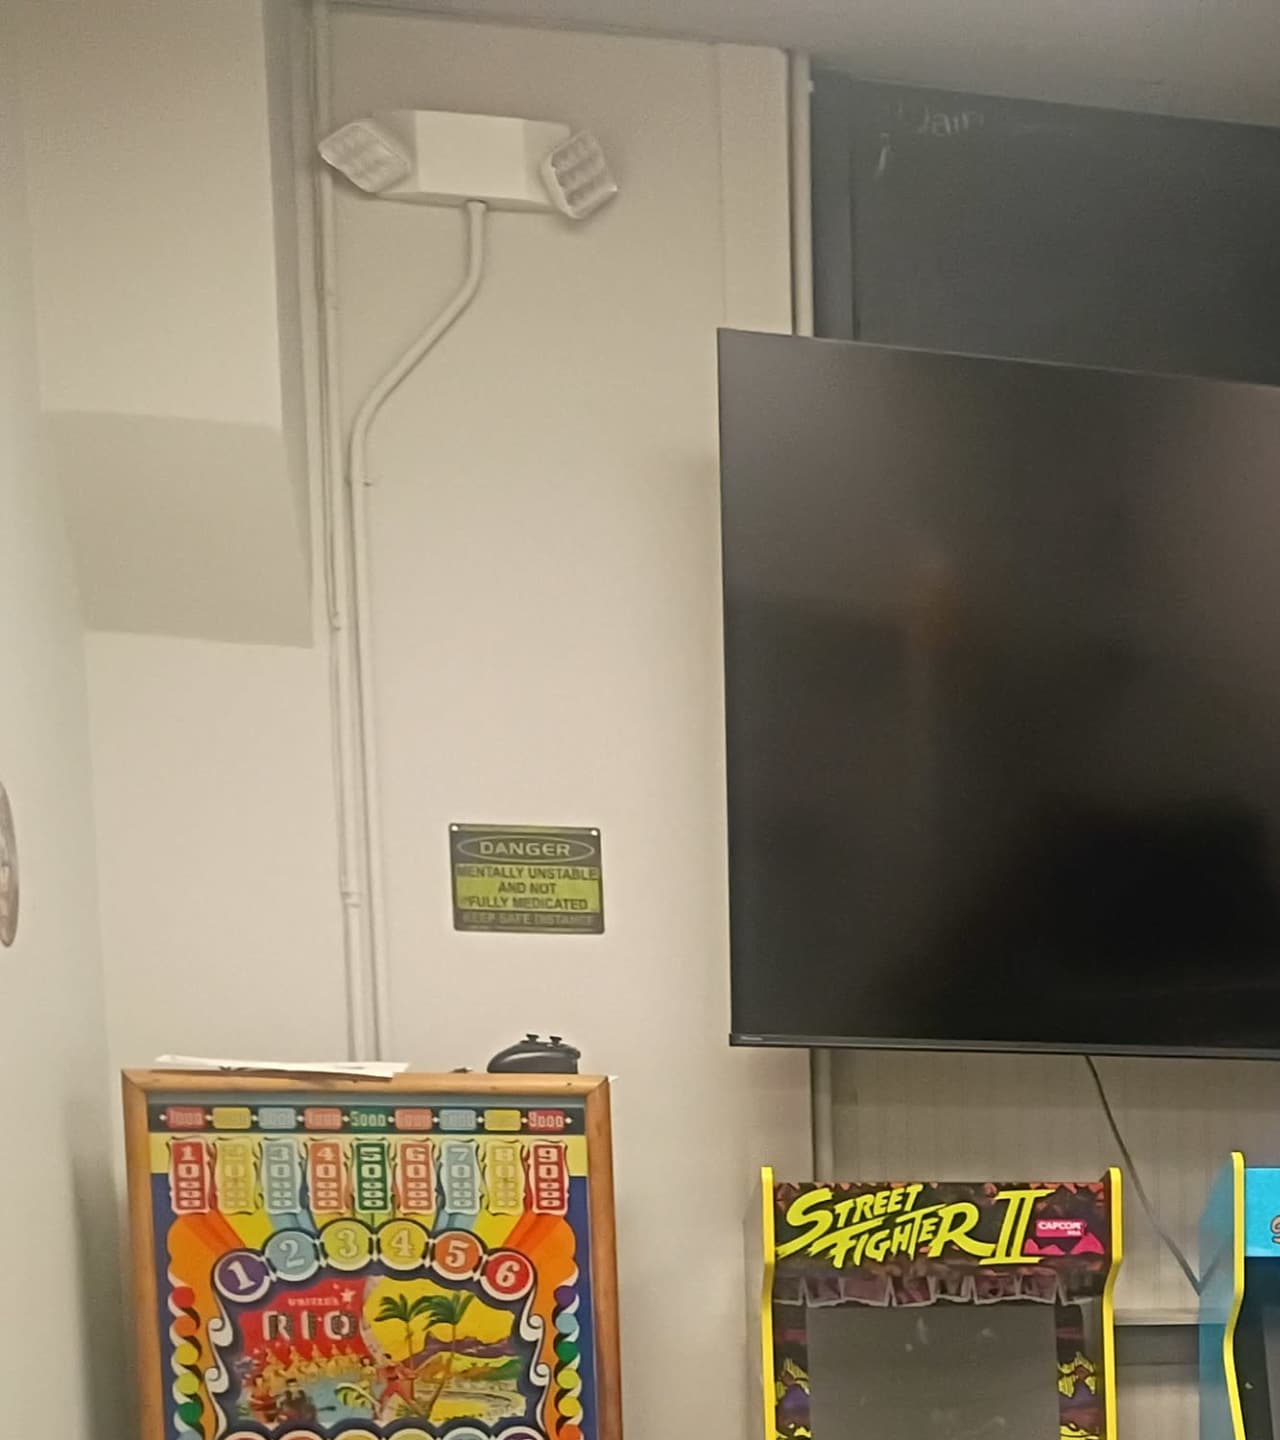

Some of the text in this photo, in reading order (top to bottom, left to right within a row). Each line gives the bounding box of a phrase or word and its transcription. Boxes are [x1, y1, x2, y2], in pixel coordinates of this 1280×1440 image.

[479, 841, 571, 857] DANGER
[457, 865, 599, 881] MENTALLY UNSTABLE
[498, 882, 557, 895] AND NOT
[513, 898, 588, 910] MEDICATED
[351, 1110, 386, 1127] 5000
[528, 1111, 564, 1128] 9000
[777, 1184, 923, 1257] STREET
[803, 1188, 1056, 1269] FIGHTER II
[1037, 1221, 1083, 1230] CAPCOM
[279, 1239, 305, 1268] 2
[338, 1228, 358, 1258] 3
[391, 1229, 413, 1258] 4
[444, 1239, 470, 1268] 5
[228, 1261, 255, 1291] 1
[495, 1259, 520, 1288] 6
[262, 1310, 358, 1342] RIO
